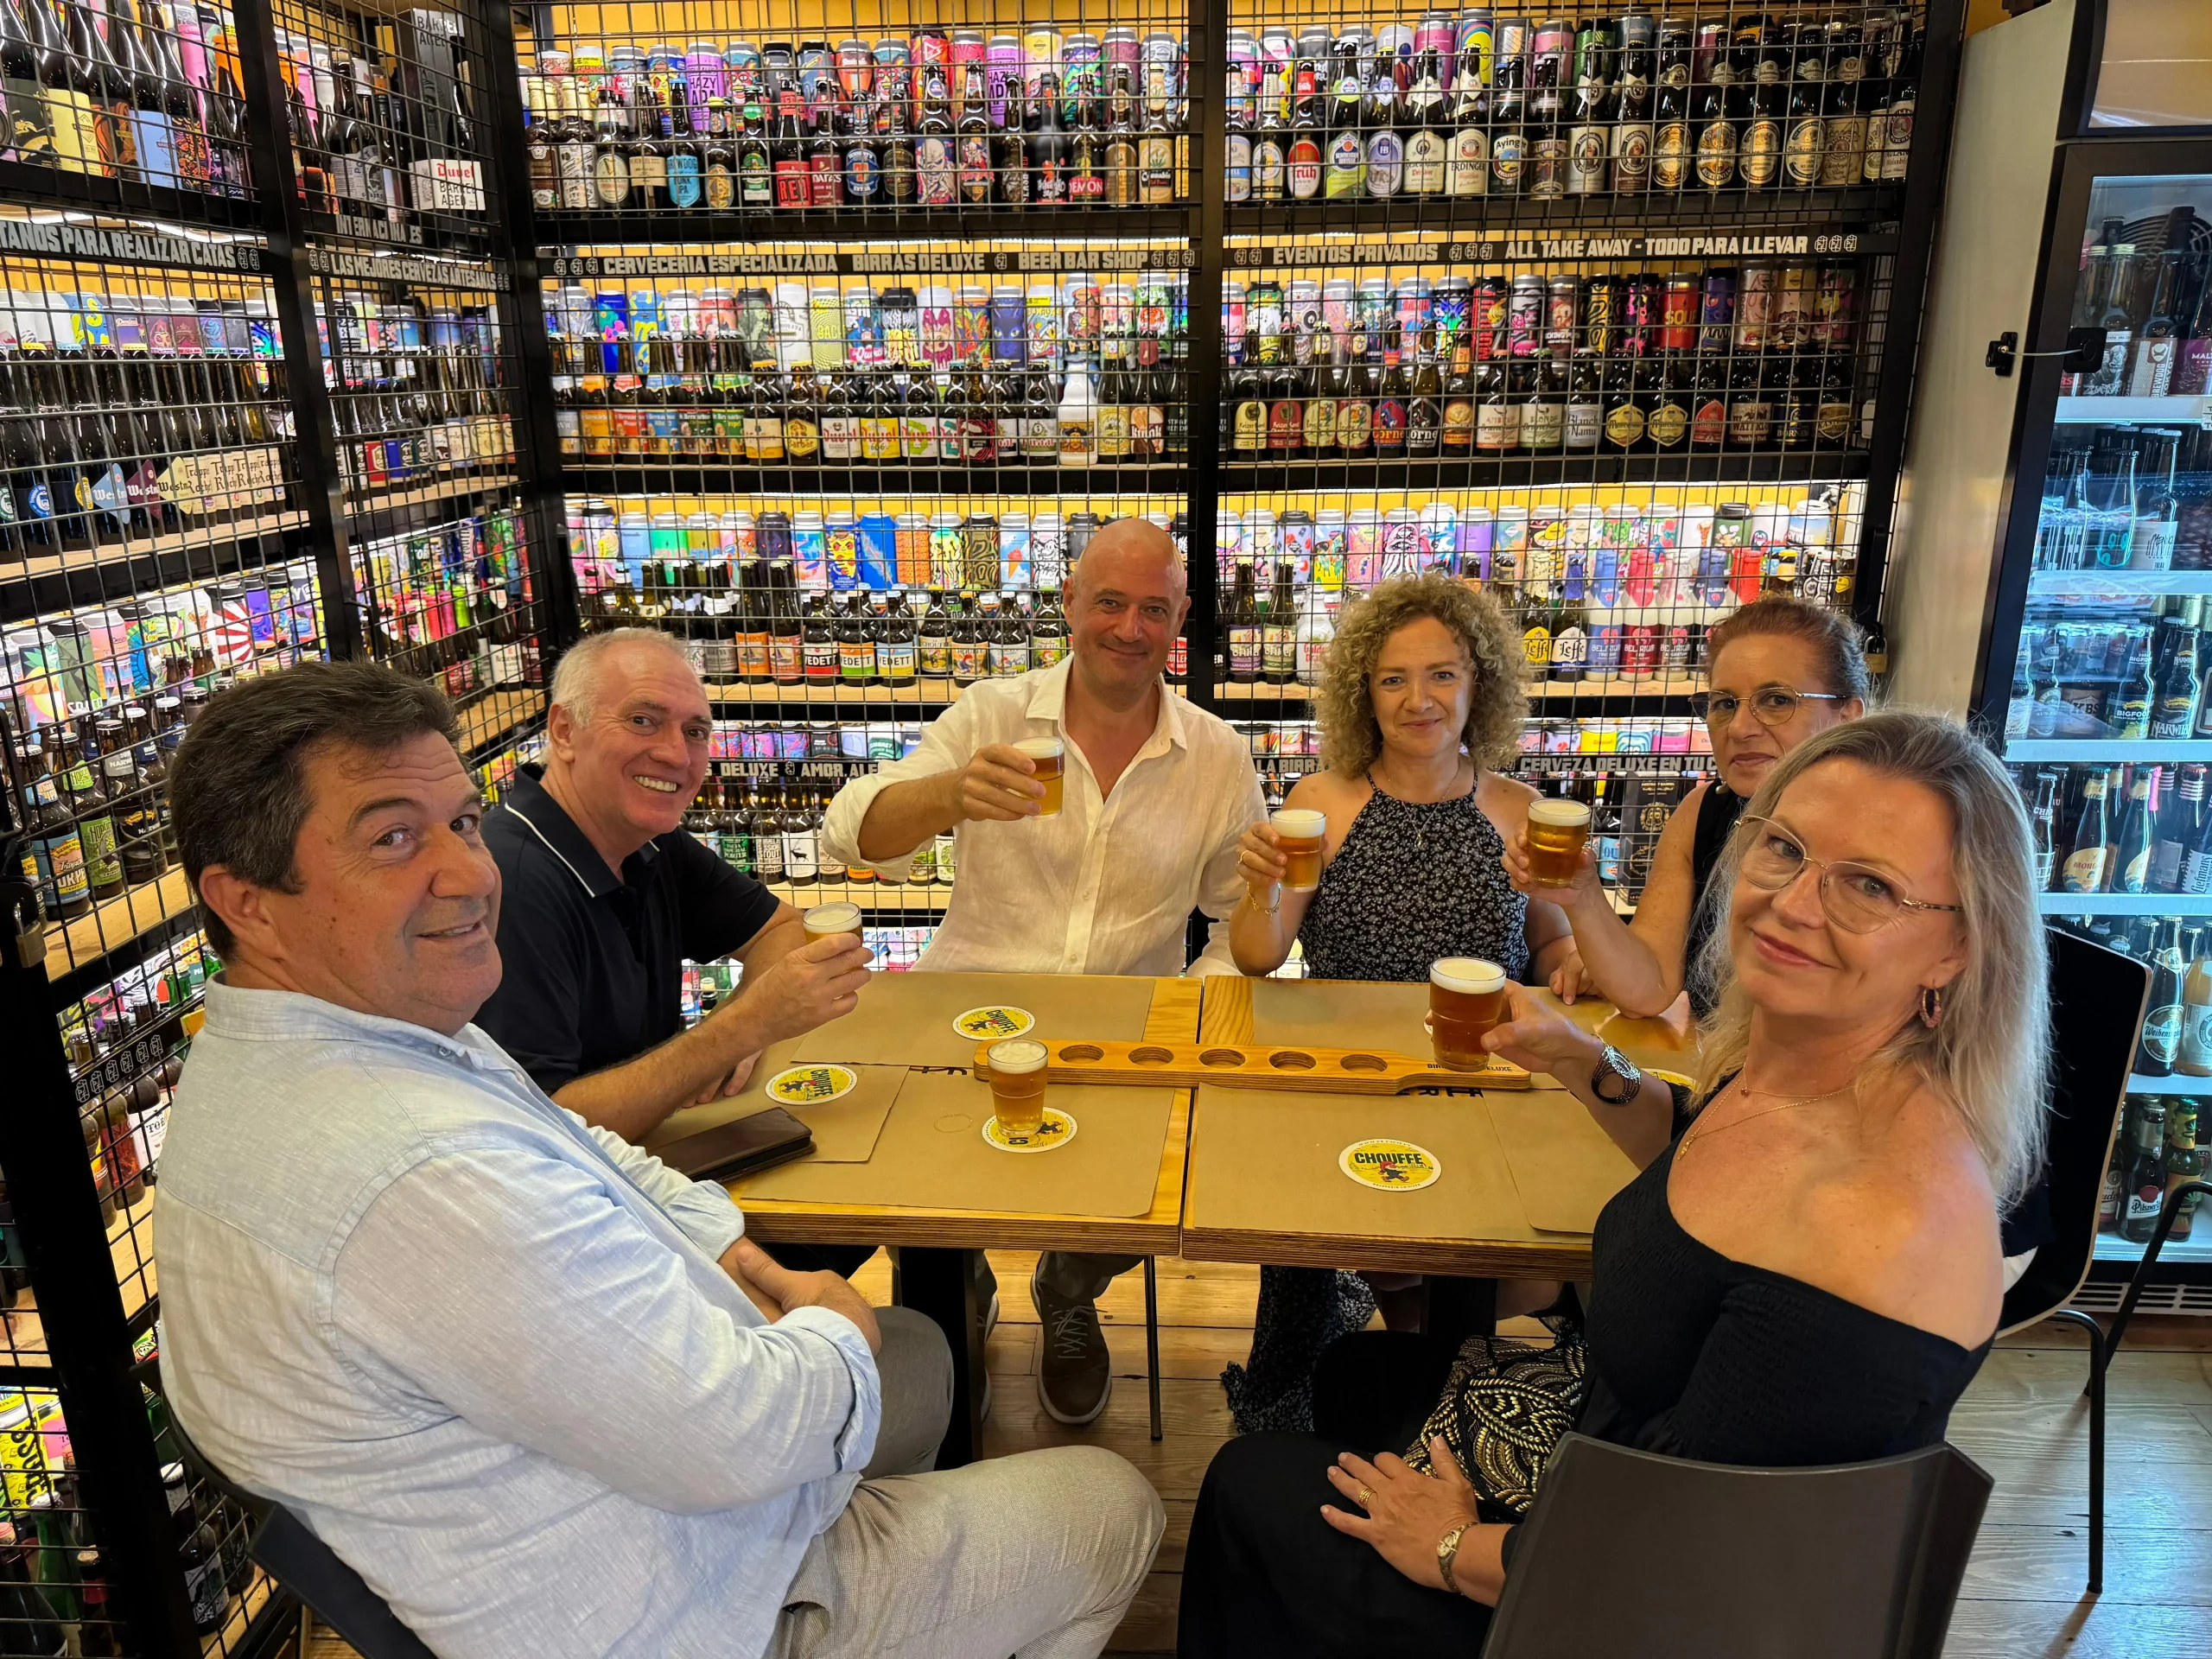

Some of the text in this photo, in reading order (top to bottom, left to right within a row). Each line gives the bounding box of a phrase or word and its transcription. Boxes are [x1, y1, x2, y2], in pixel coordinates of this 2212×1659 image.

[60, 226, 112, 257] PARA
[110, 232, 193, 265] REALIZAR
[191, 240, 237, 269] CATAS
[1273, 245, 1439, 265] EVENTOS PRIVADOS
[1504, 240, 1538, 259] ALL
[1541, 239, 1585, 257] TAKE
[1586, 238, 1633, 257] AWAY
[1644, 238, 1690, 256] TODO
[1693, 236, 1738, 255] PARA
[1741, 235, 1808, 255] LLEVAR
[330, 253, 498, 291] LAS MEJORES CERVEZAS ARTESANAS
[604, 251, 1148, 276] CERVECERIA ESPECIALIZADA BIRRAS DELUXE BEER BAR SHOP
[720, 762, 779, 777] DELUXE
[1255, 759, 1276, 773] LA
[1520, 757, 1592, 772] CERVEZA
[1596, 756, 1658, 772] DELUXE
[1659, 756, 1682, 772] EN
[1684, 756, 1706, 771] TU
[1354, 1152, 1424, 1165] CHOUFFE
